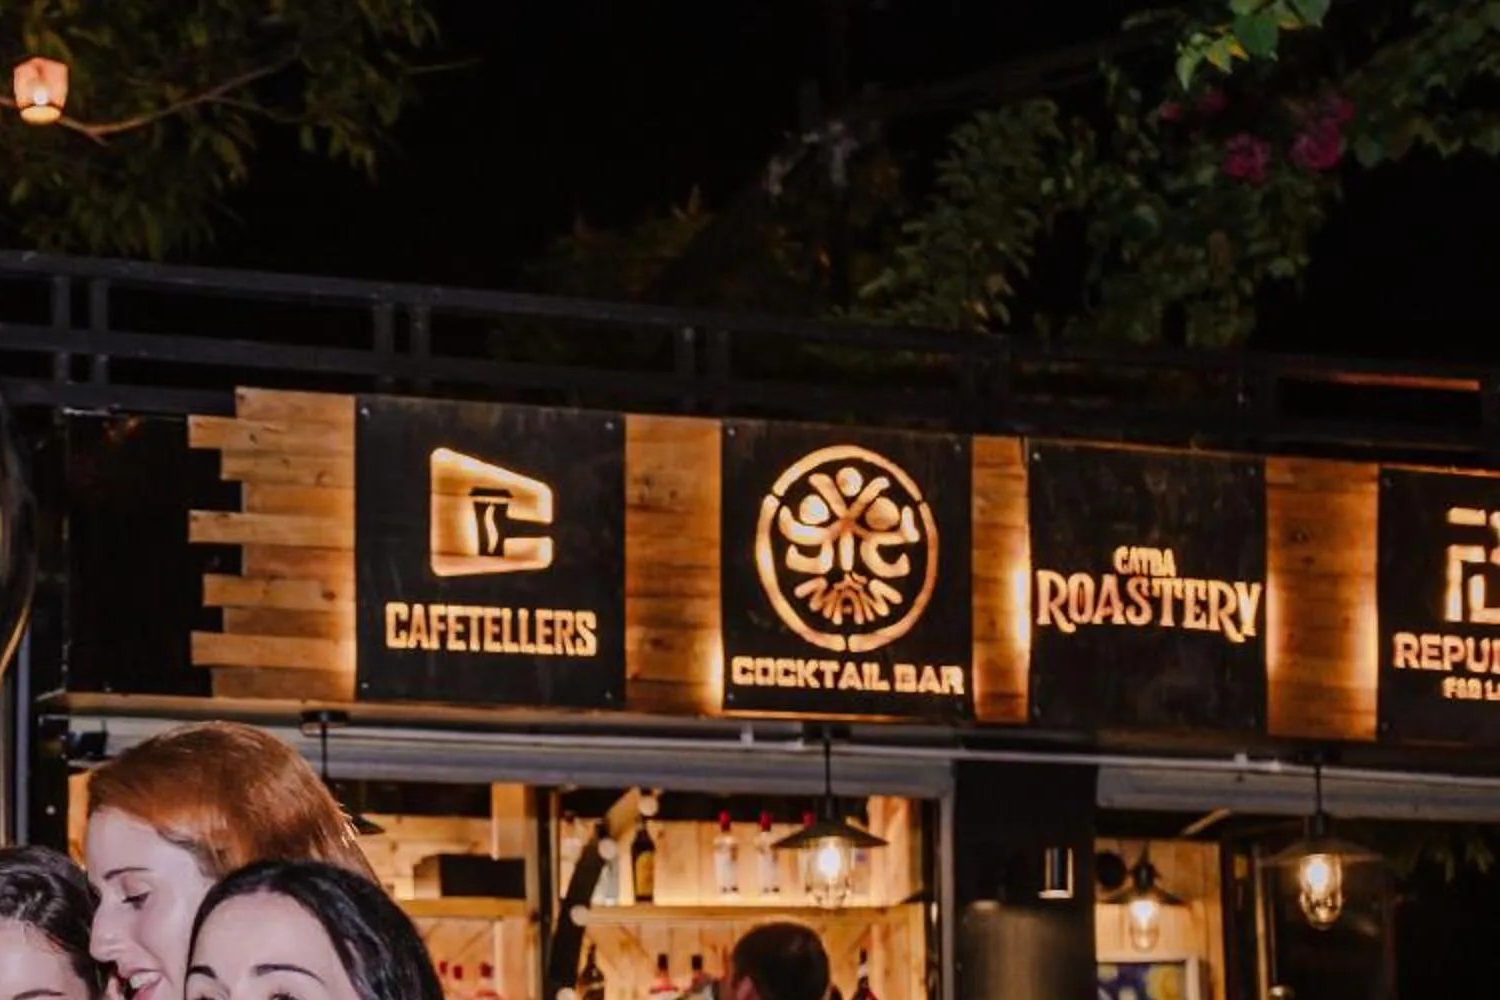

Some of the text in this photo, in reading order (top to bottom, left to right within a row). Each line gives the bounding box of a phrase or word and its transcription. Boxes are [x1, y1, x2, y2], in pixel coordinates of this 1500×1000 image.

[1113, 545, 1177, 578] CATBA
[385, 602, 597, 656] CAFETELLERS
[1036, 569, 1262, 643] ROASTERY
[731, 655, 965, 695] COCKTAIL BAR
